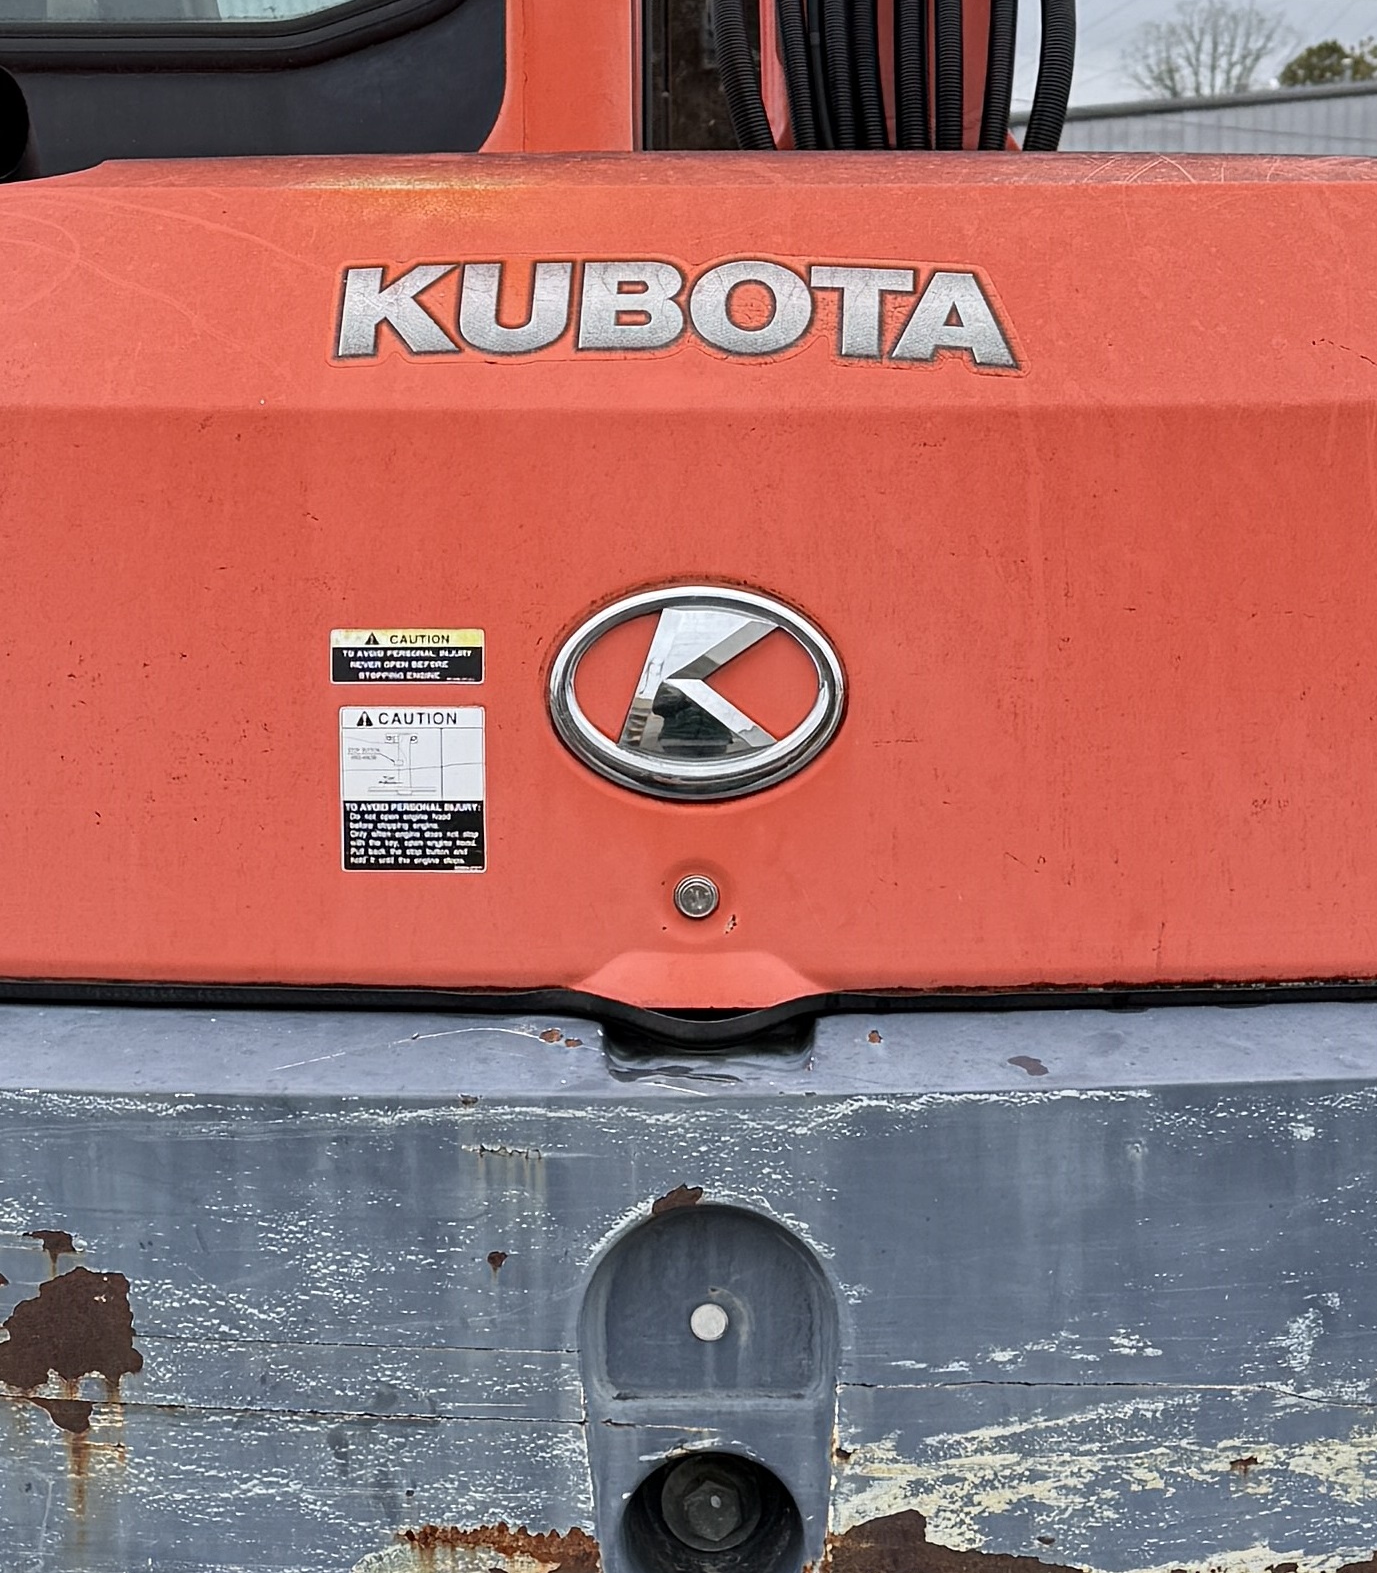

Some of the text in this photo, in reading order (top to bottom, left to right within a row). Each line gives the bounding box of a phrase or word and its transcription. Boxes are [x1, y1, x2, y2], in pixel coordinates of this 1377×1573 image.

[337, 260, 1022, 370] KUBOTA
[389, 634, 450, 644] CAUTION
[378, 712, 457, 725] CAUTION
[345, 803, 358, 811] TO
[360, 803, 388, 811] AVOID
[391, 803, 441, 811] PERSONAL
[380, 813, 399, 821] open
[403, 813, 428, 821] engine
[377, 822, 408, 830] stopping
[414, 857, 439, 865] engine
